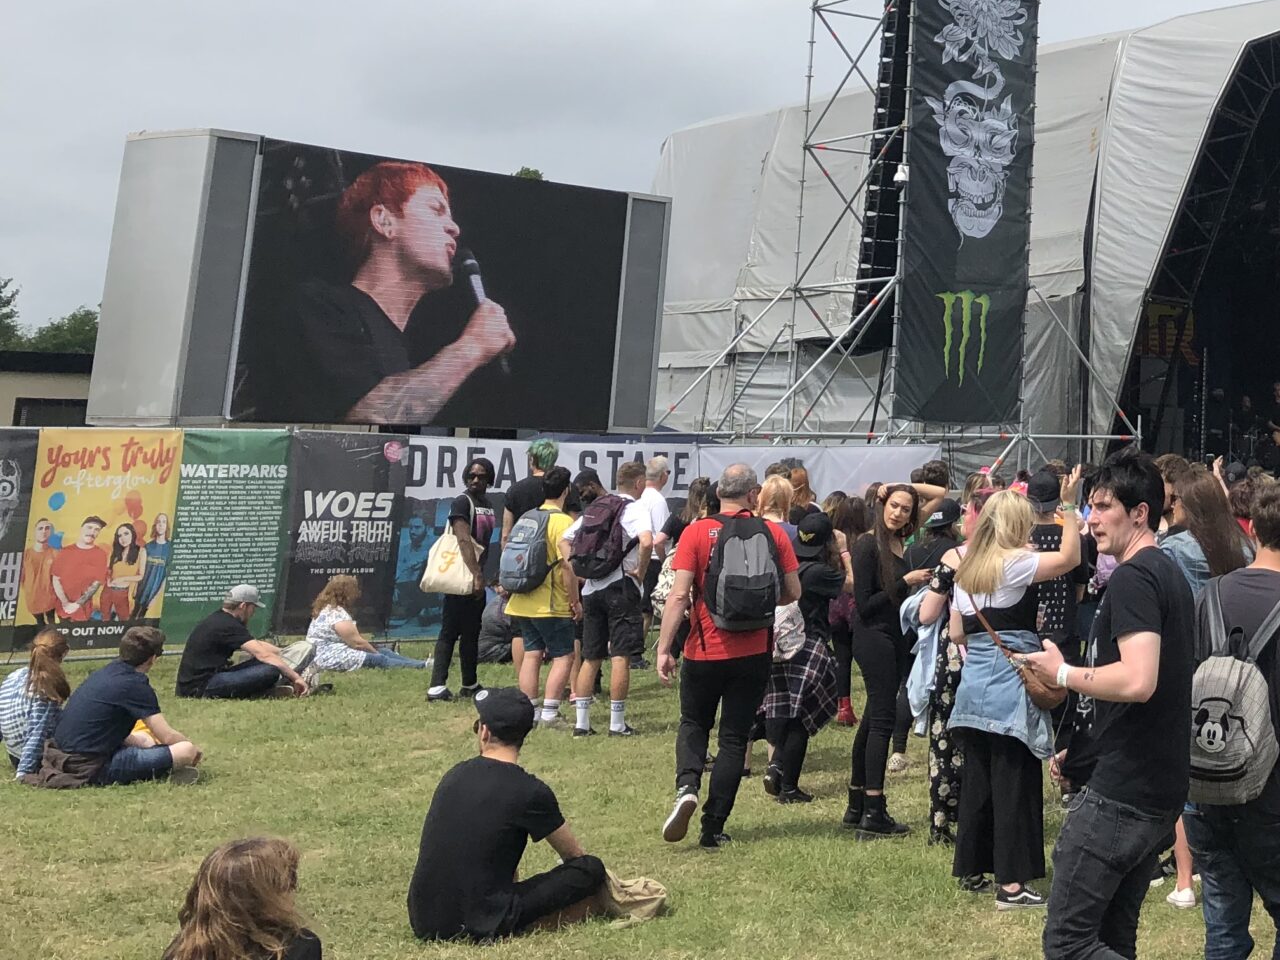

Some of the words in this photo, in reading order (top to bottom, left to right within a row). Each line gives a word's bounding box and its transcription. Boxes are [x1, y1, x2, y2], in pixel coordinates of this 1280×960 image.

[41, 444, 111, 488] yours
[120, 436, 177, 484] truly
[180, 464, 288, 478] WATERPARKS
[405, 443, 535, 489] DRA
[578, 449, 690, 491] STE
[63, 469, 156, 499] afterglow
[304, 490, 395, 519] WOES
[72, 627, 95, 636] OUT
[97, 625, 125, 636] NOW
